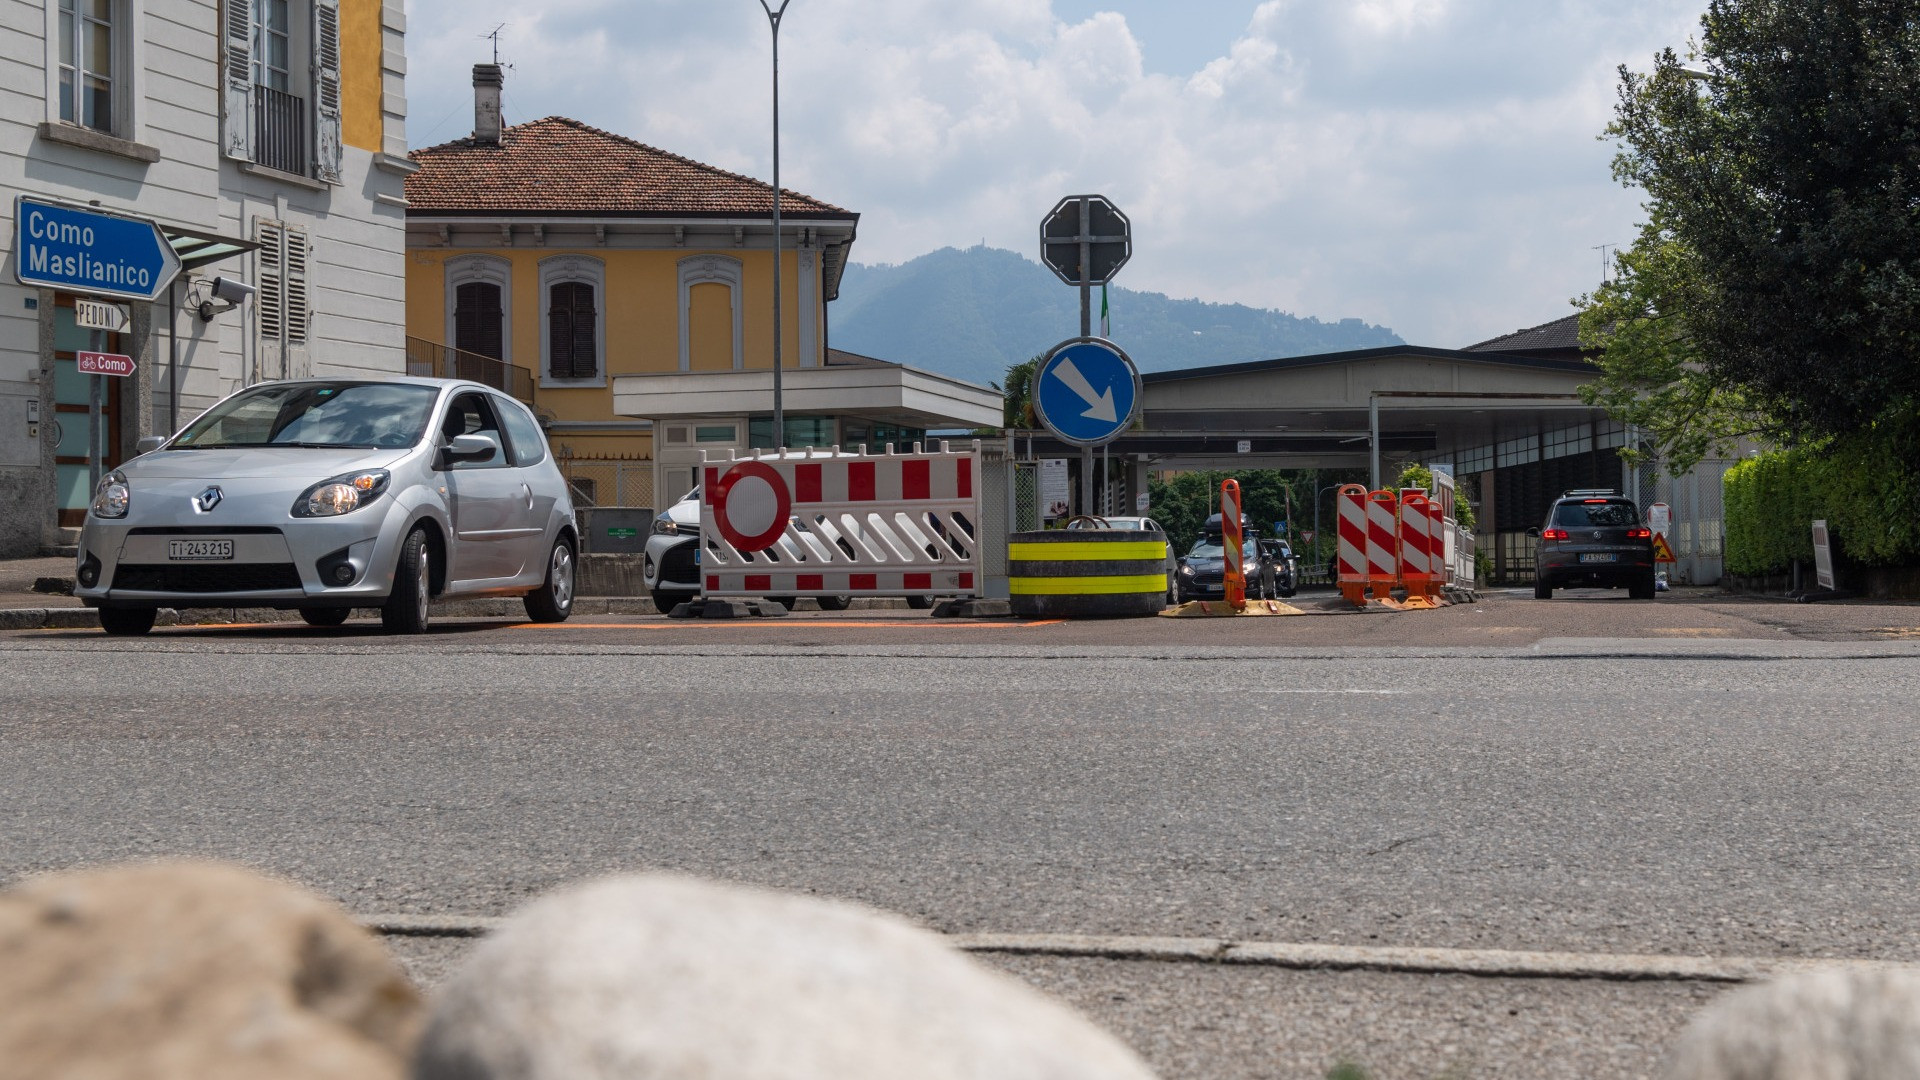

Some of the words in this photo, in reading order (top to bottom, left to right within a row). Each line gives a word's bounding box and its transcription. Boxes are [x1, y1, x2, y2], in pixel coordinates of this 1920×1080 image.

[29, 210, 94, 246] Como
[29, 244, 149, 287] Maslianico
[79, 303, 114, 328] PEDONI
[97, 355, 127, 372] Como
